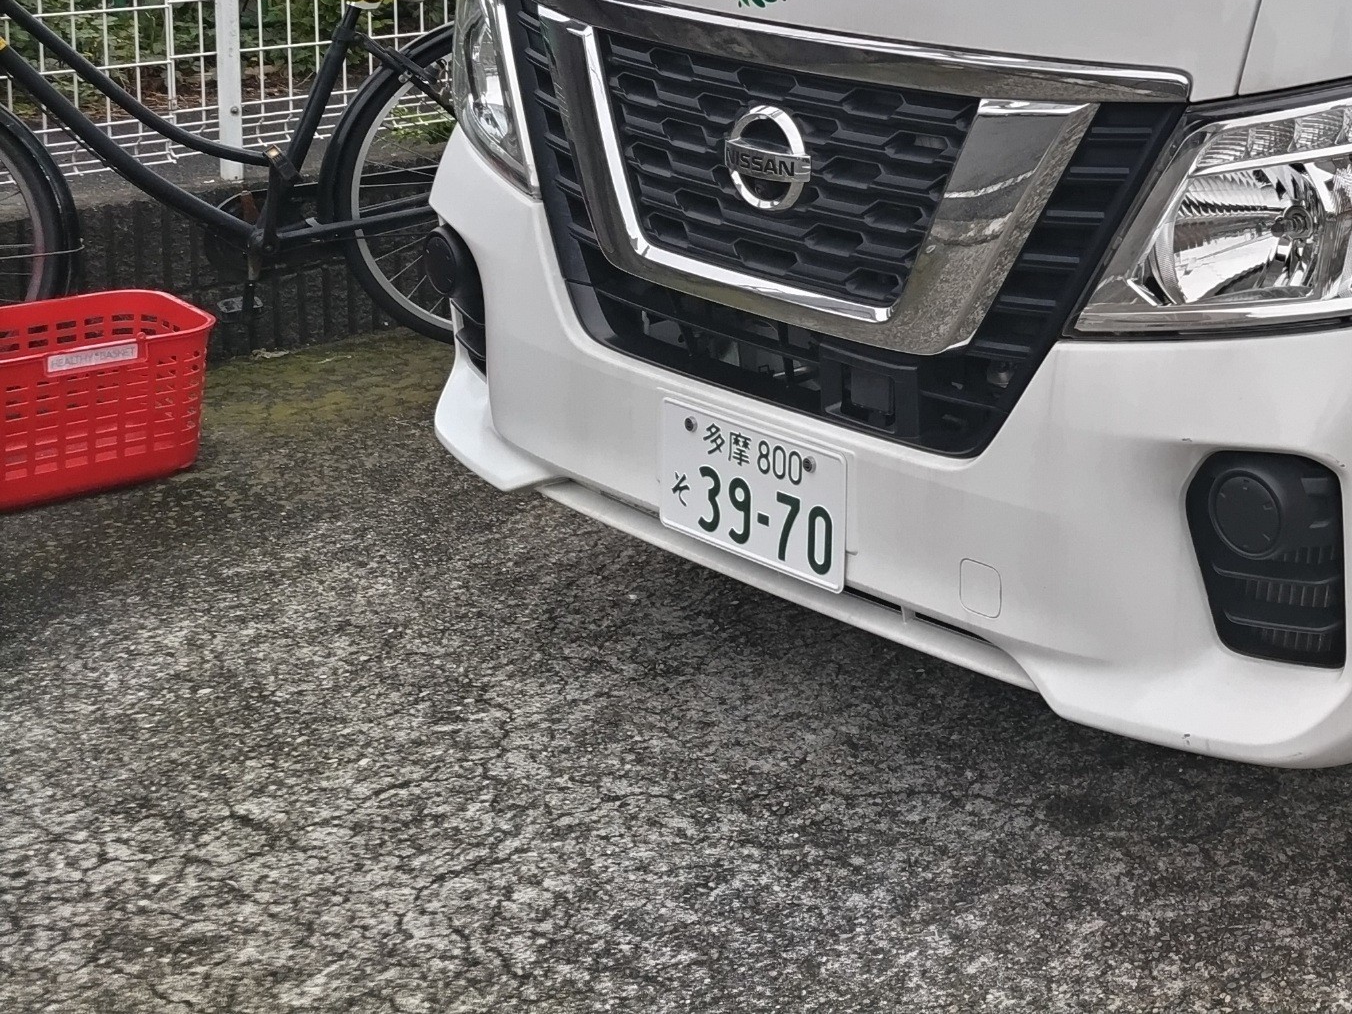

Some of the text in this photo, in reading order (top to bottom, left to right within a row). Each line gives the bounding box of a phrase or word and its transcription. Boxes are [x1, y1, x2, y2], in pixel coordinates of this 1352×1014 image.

[727, 149, 795, 177] NISSAN
[702, 422, 804, 487] 多摩 800
[671, 465, 834, 576] そ 39-70
